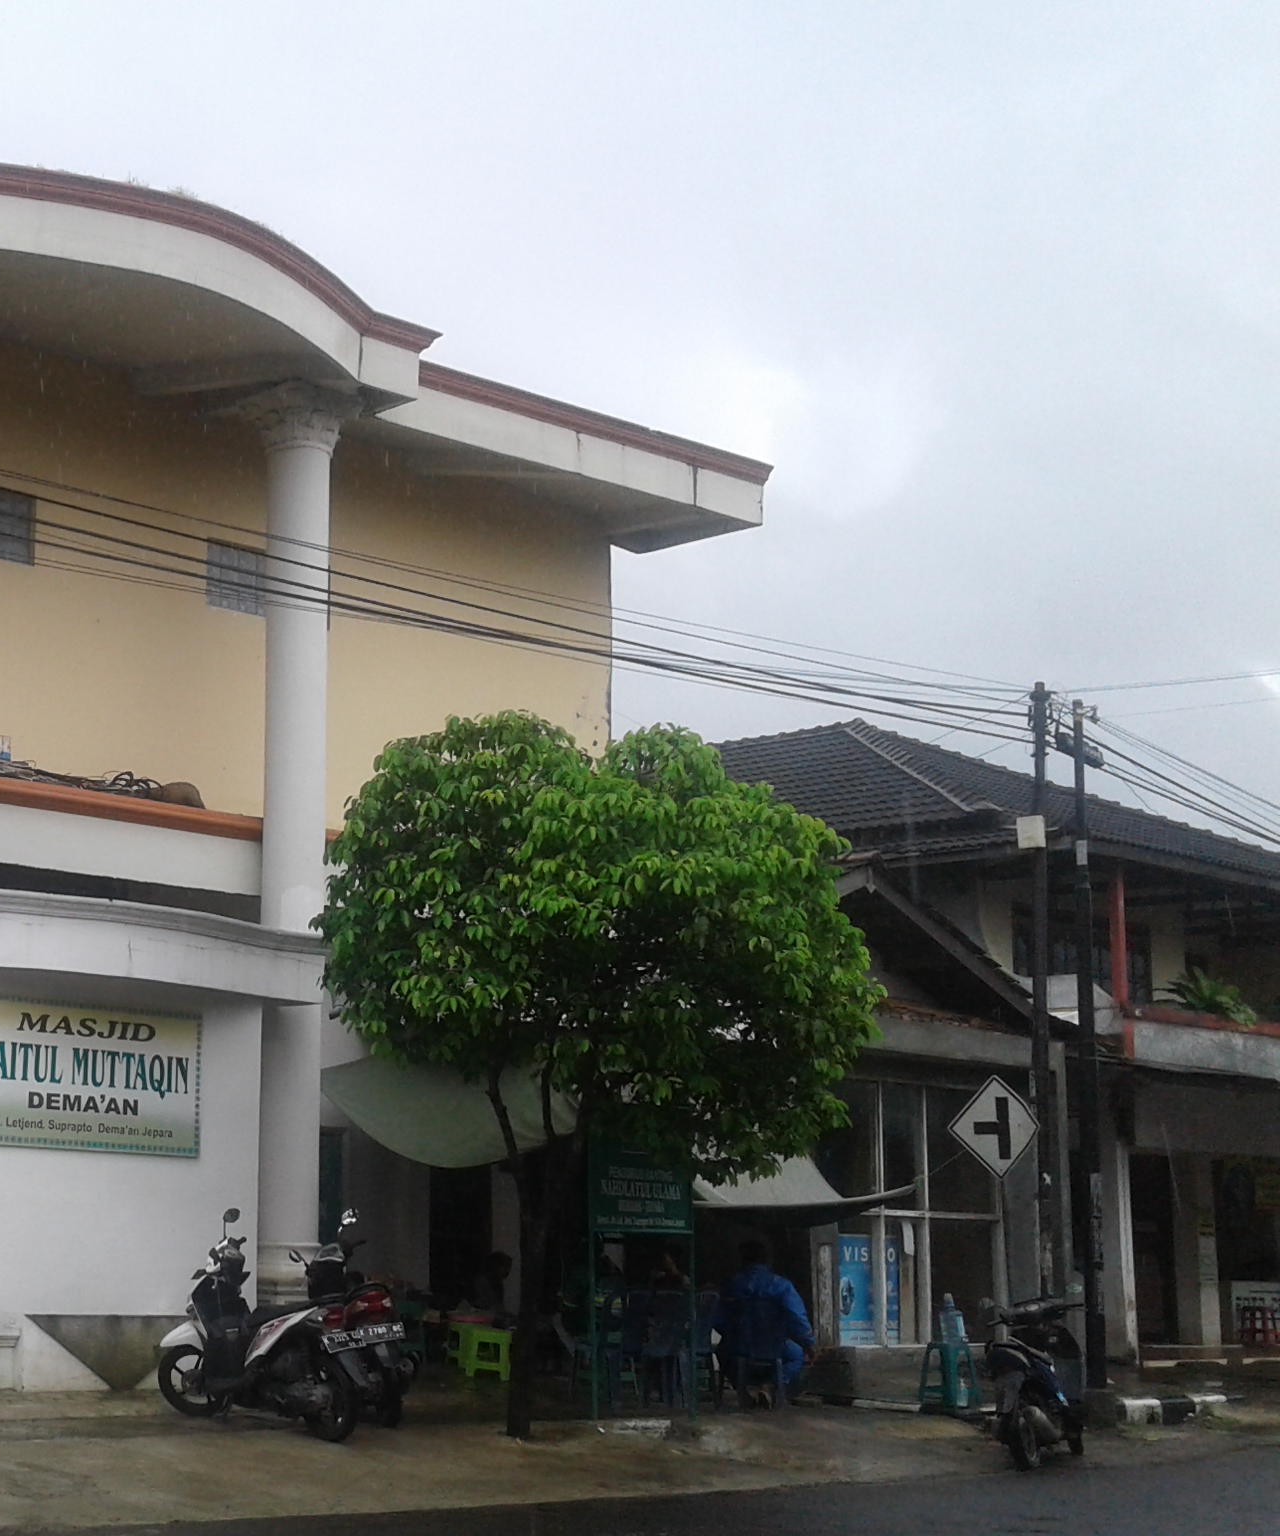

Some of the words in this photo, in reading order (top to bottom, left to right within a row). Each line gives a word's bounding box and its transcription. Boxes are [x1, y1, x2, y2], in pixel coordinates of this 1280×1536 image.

[16, 1012, 156, 1043] MASJID
[71, 1047, 190, 1100] MUTTAQIN
[27, 1090, 139, 1116] DEMA'AN
[48, 1119, 93, 1135] Suprapto
[98, 1122, 139, 1136] Dema'an
[141, 1126, 173, 1139] Jepara
